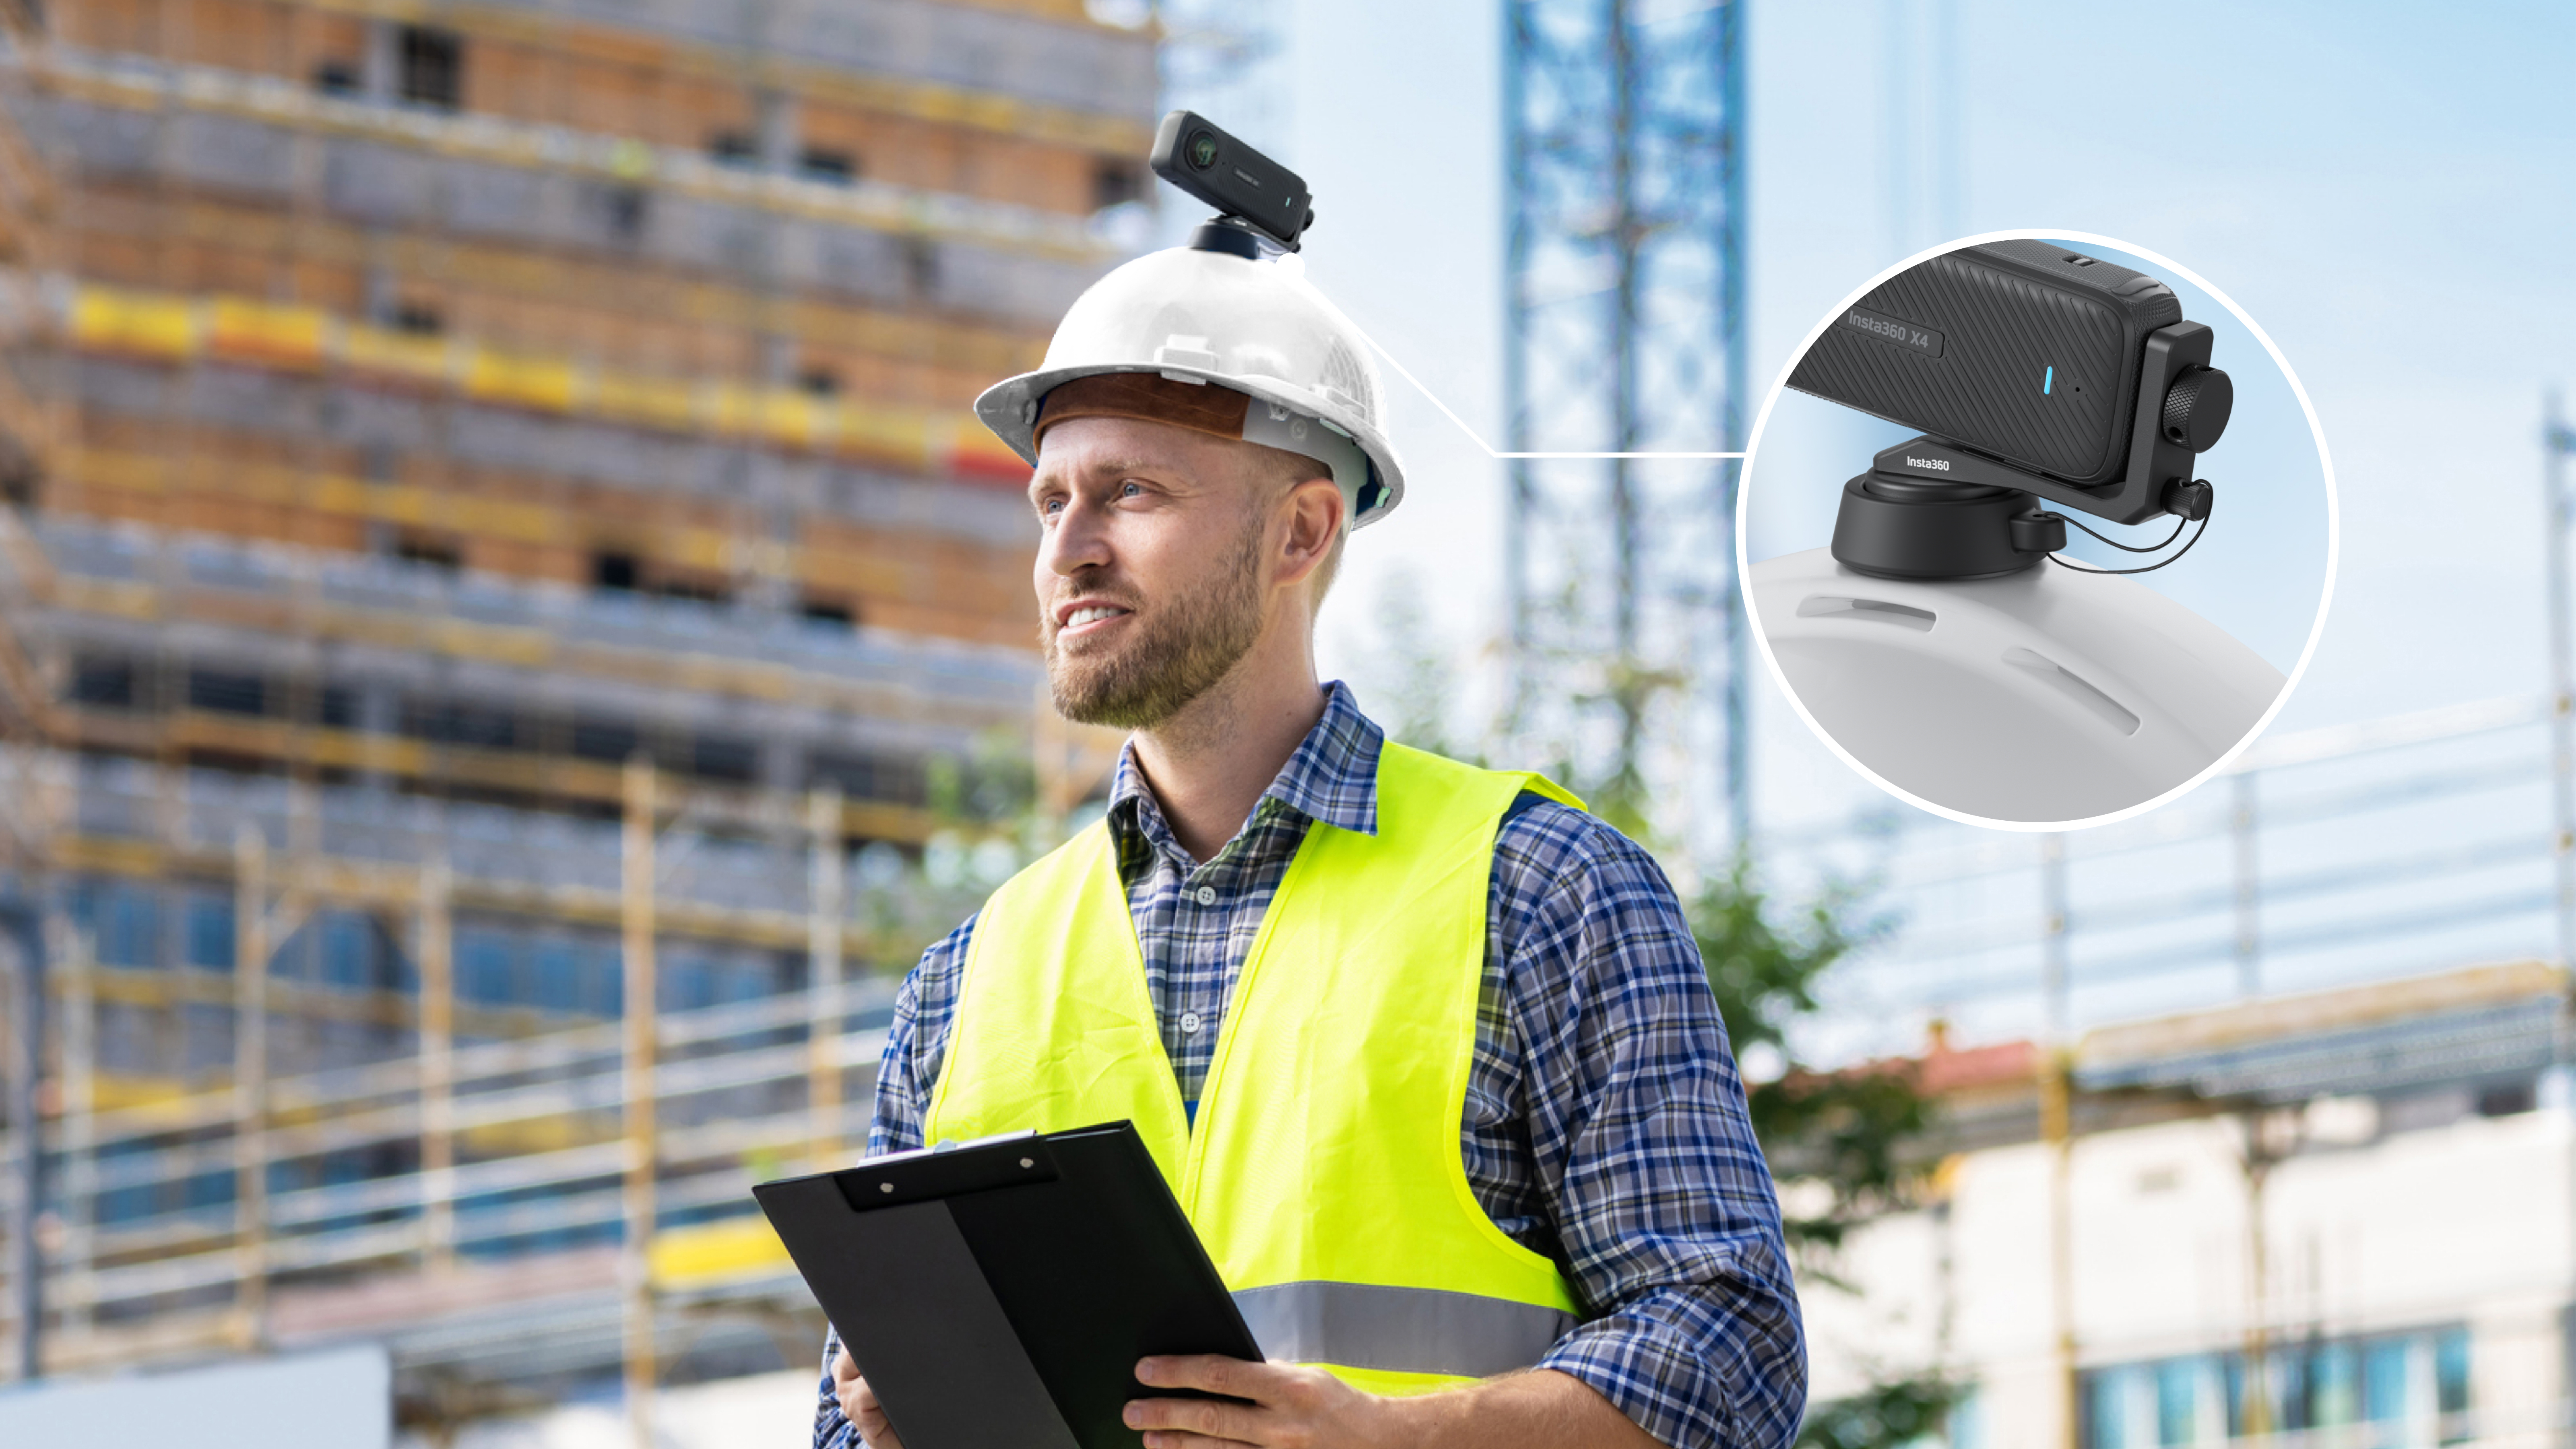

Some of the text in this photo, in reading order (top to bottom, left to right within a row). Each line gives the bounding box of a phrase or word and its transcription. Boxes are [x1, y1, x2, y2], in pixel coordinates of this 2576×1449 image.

[1849, 310, 1928, 348] Insta360 X4
[1907, 456, 1949, 471] Insta360
